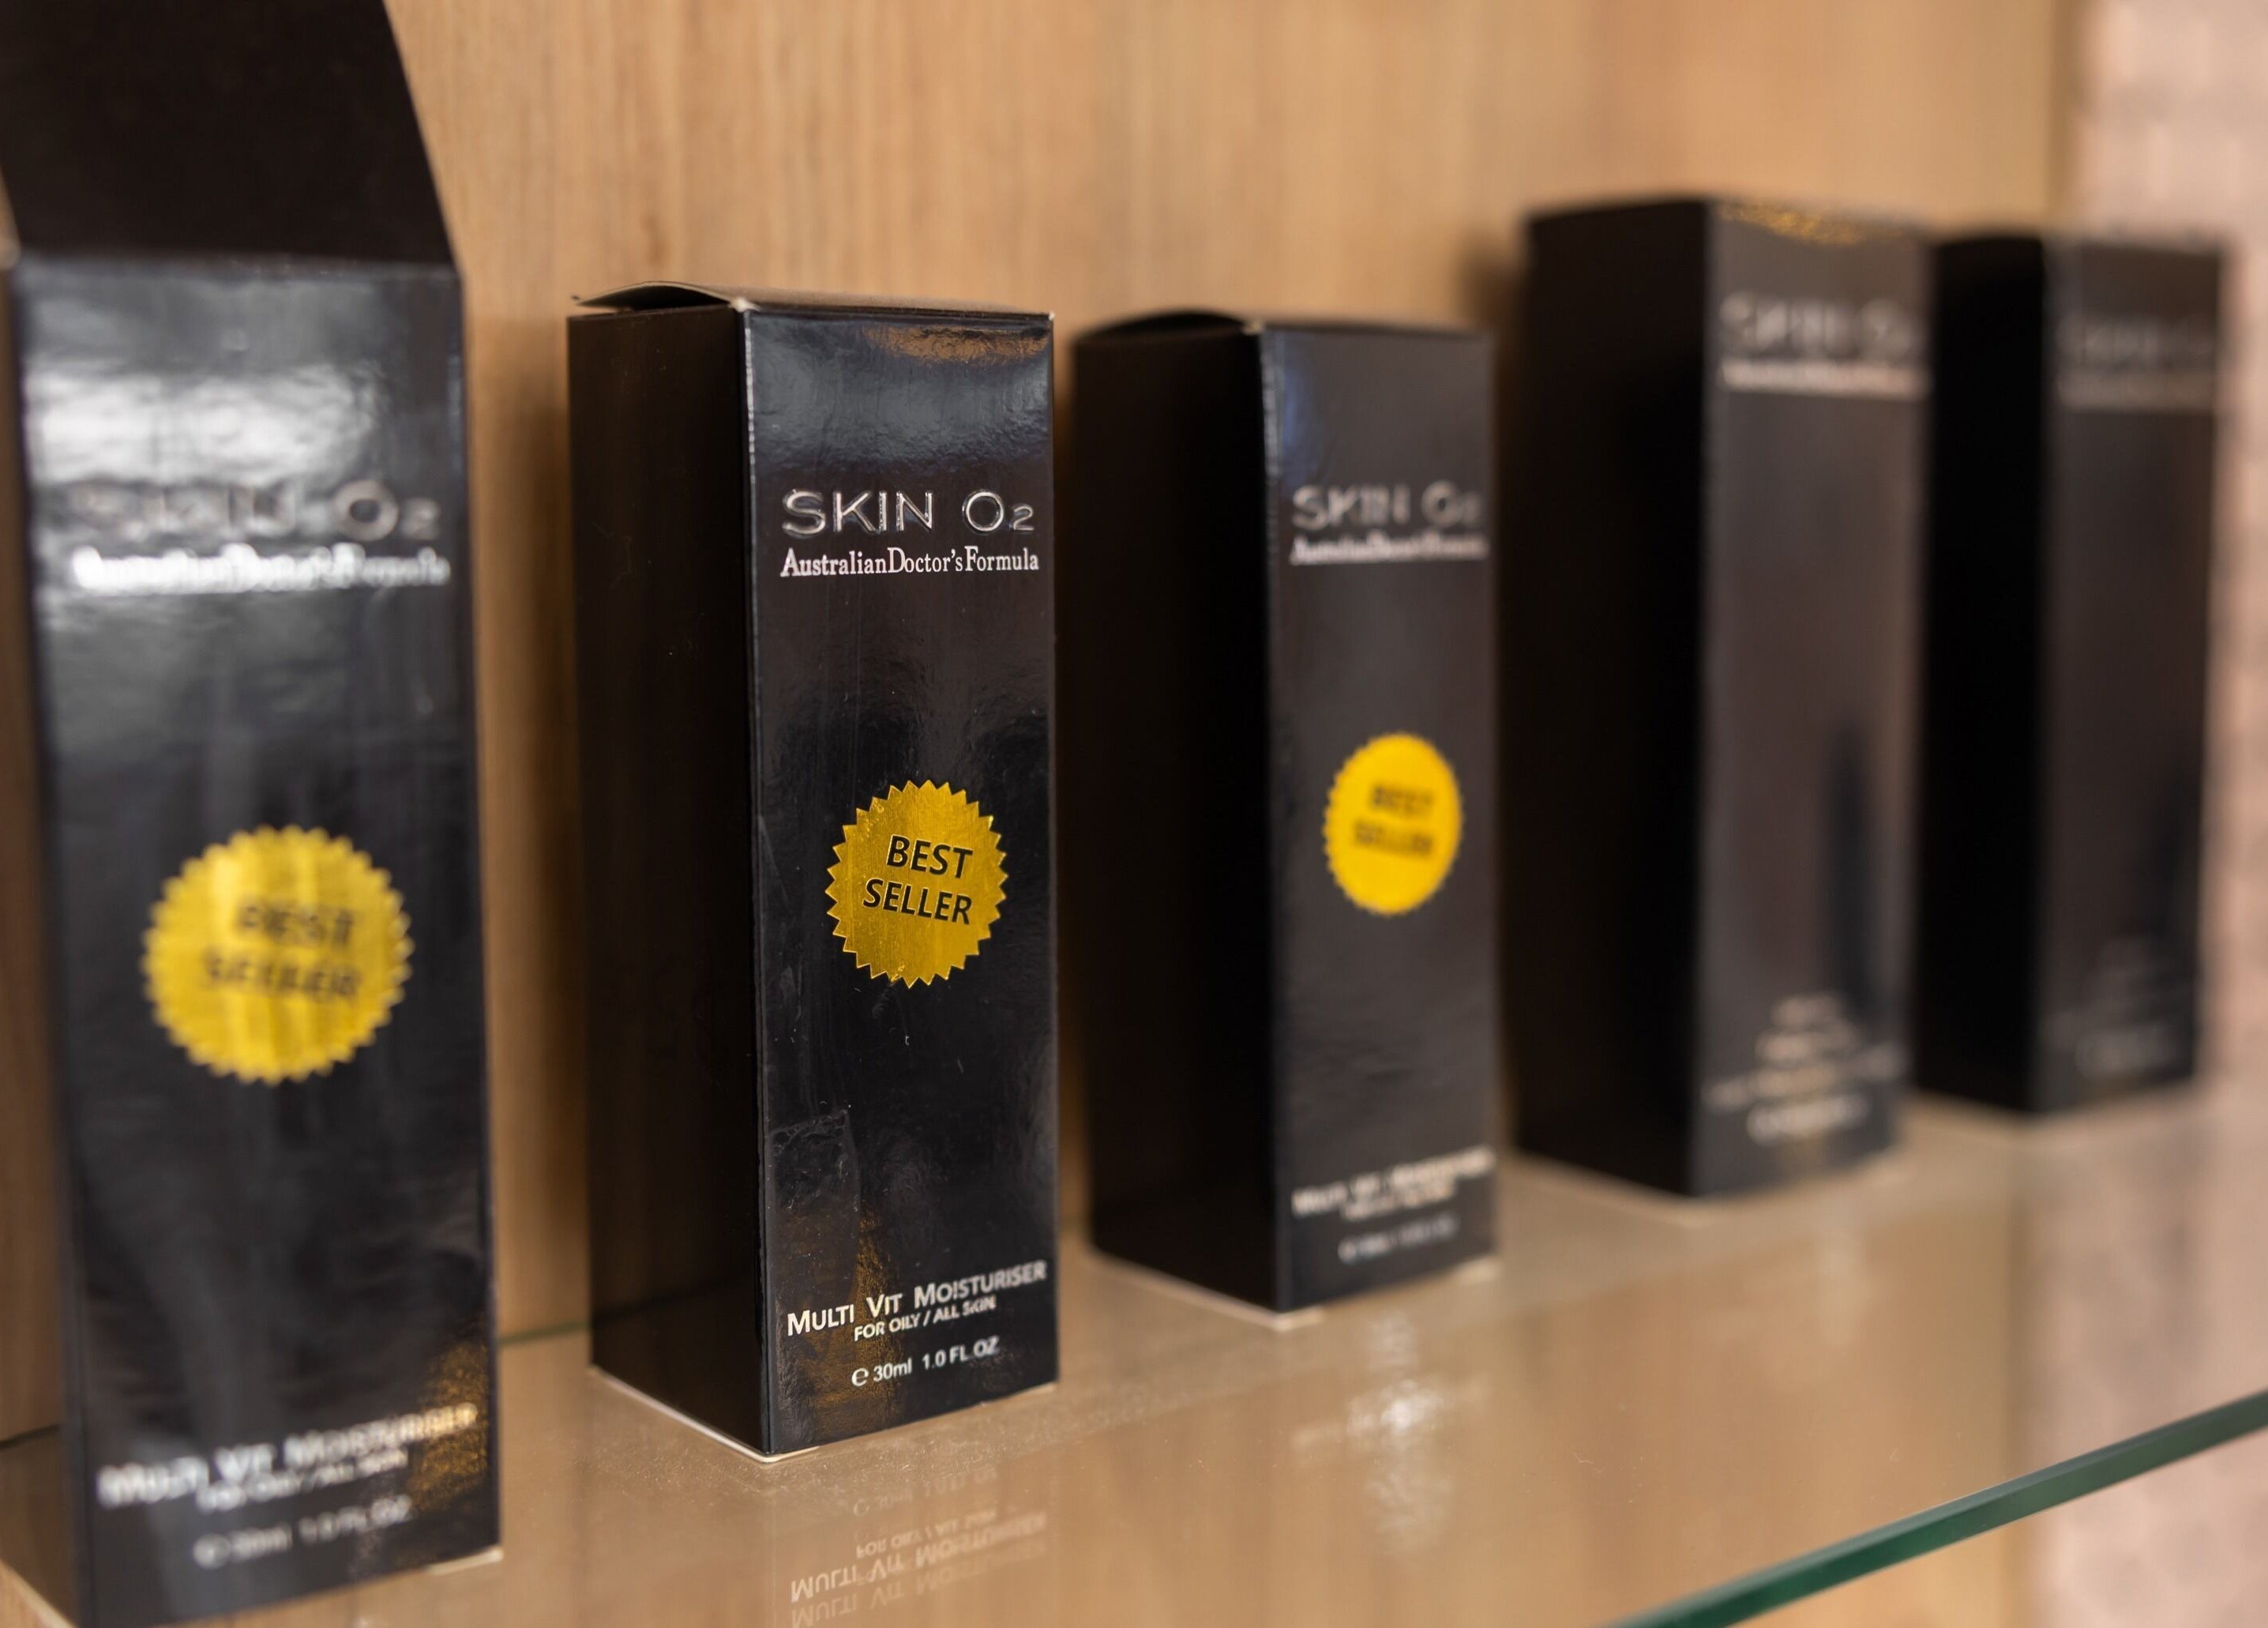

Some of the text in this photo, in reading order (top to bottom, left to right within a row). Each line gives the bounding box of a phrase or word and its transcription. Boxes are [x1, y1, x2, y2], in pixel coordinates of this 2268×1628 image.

[782, 489, 933, 539] SKIN
[887, 834, 973, 878] BEST
[862, 878, 972, 925] SELLER
[787, 1304, 854, 1337] MULTI
[866, 1293, 903, 1318] VIT
[854, 1321, 885, 1341] FOR
[889, 1312, 921, 1333] OILY
[933, 1305, 959, 1325] ALL
[873, 1358, 912, 1382] 30ml
[922, 1350, 947, 1370] 1.0
